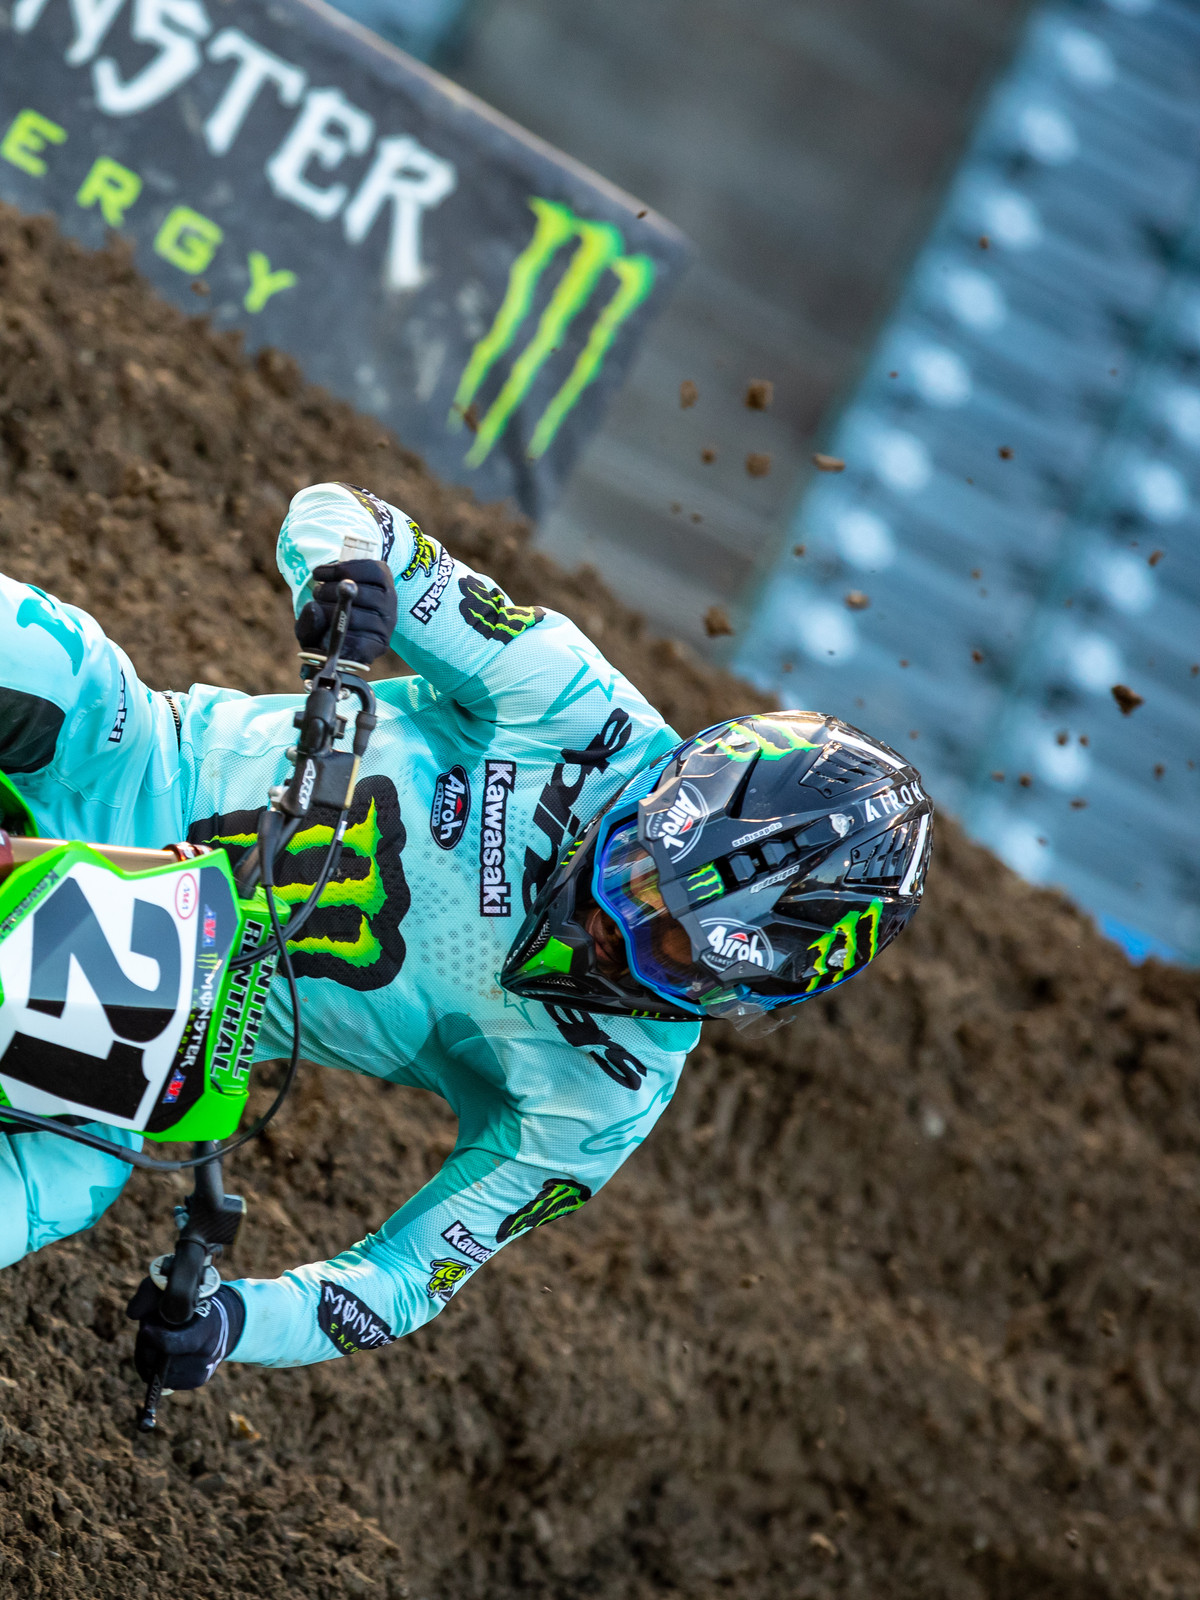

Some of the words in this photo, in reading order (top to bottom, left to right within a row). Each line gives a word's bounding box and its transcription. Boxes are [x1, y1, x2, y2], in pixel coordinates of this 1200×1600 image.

[440, 773, 467, 841] Airoh
[865, 781, 925, 822] AIROH
[483, 762, 513, 915] Kawasaki
[202, 904, 217, 948] AMA
[707, 925, 764, 967] Airoh
[162, 1068, 187, 1104] AMA
[324, 1284, 392, 1346] MONST
[328, 1321, 362, 1355] ENER
